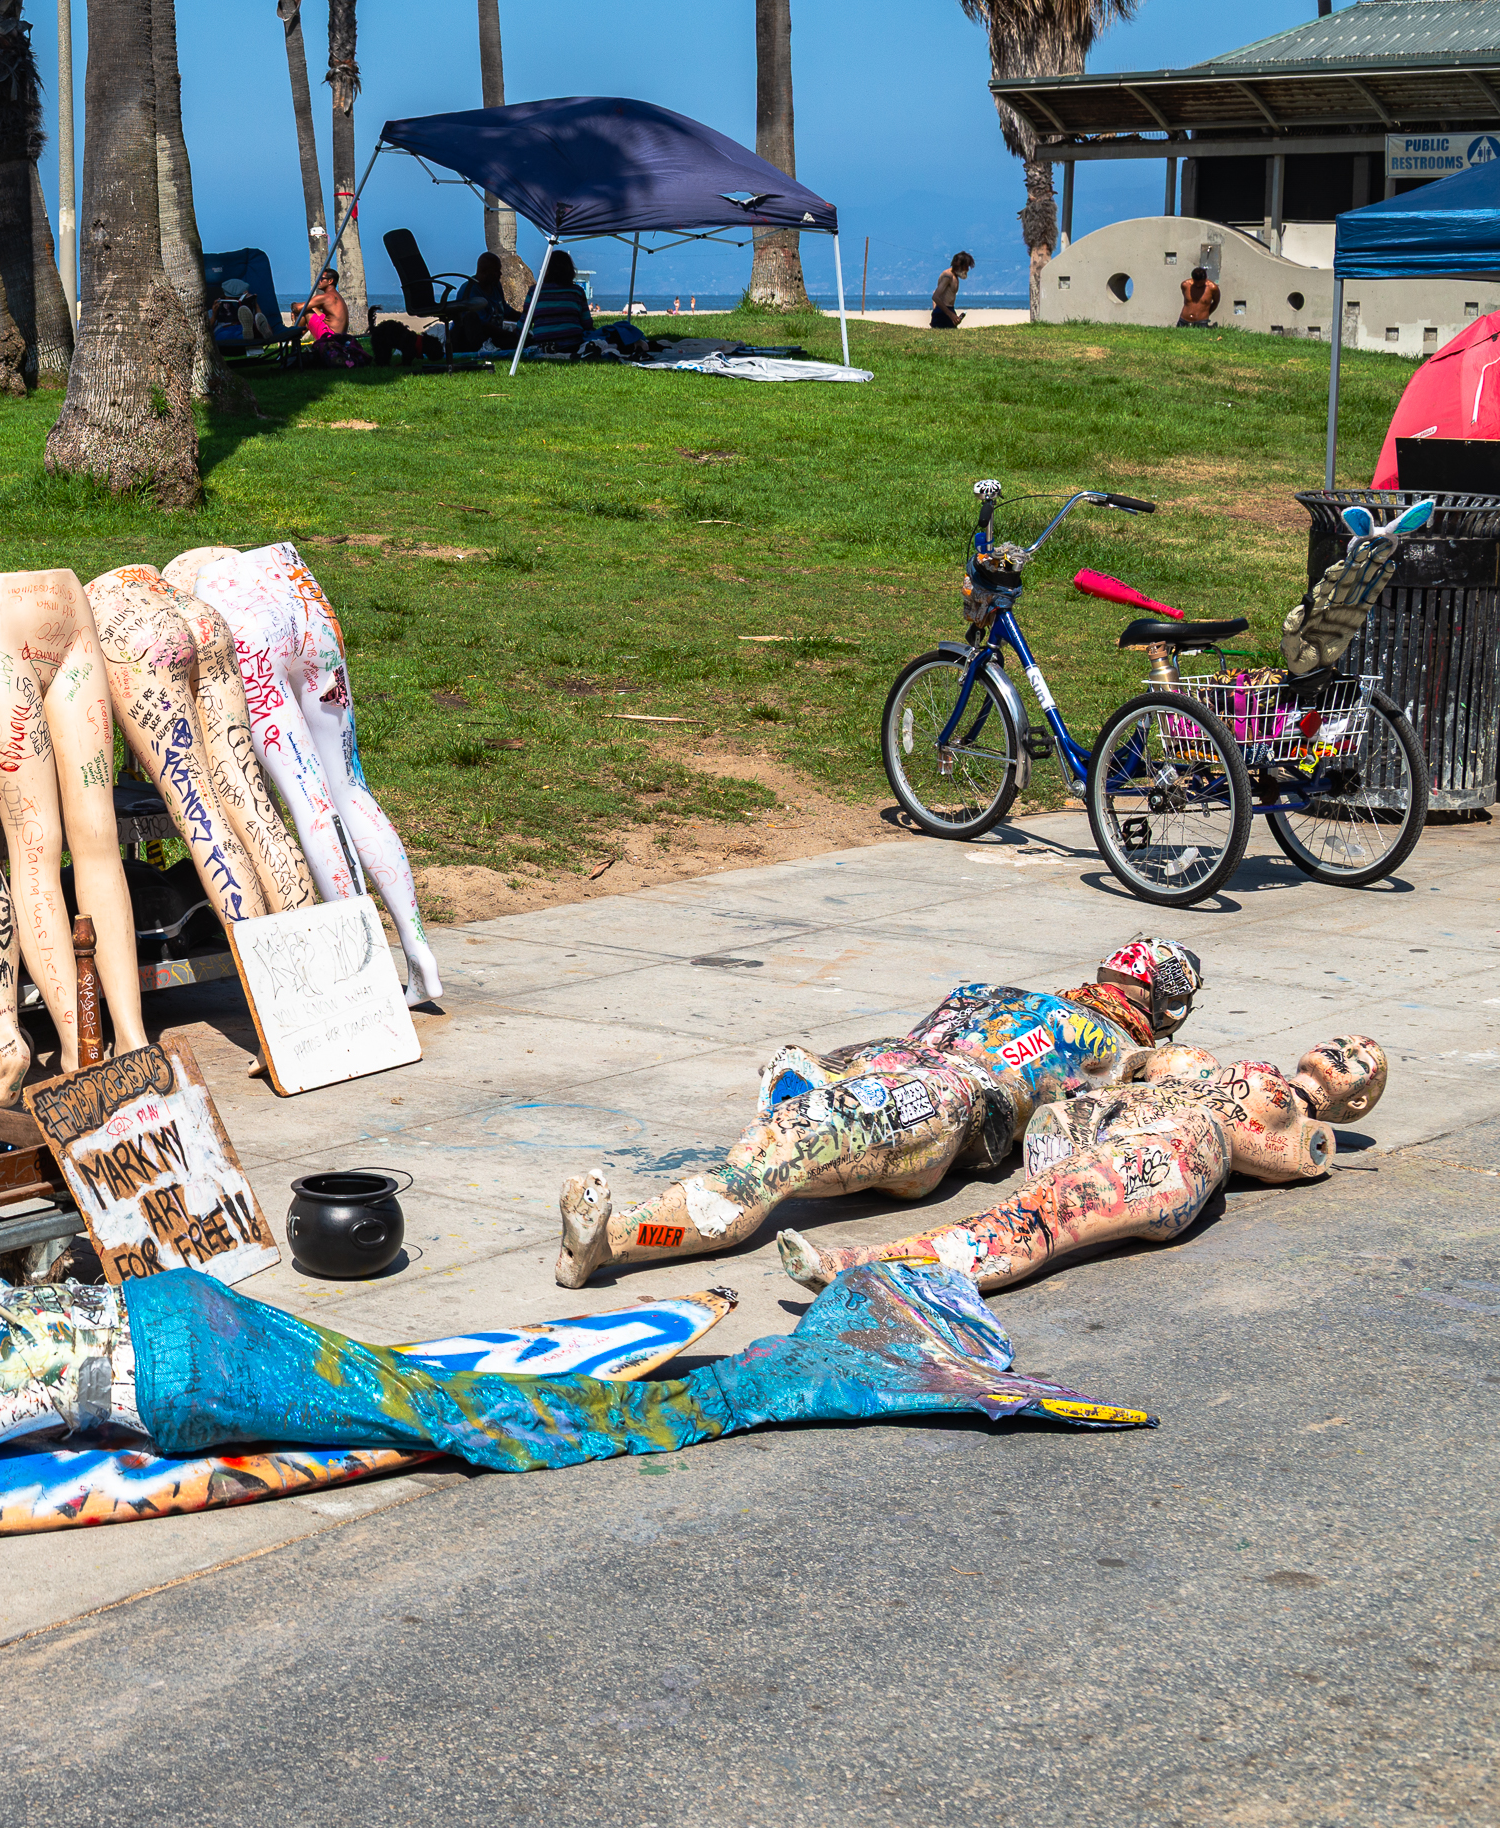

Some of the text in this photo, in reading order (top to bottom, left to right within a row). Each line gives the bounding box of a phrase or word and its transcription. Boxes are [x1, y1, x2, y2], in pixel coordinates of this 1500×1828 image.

[1391, 156, 1464, 170] RESTROOMS
[1405, 138, 1450, 152] PUBLIC
[78, 1133, 153, 1211] MARK
[150, 1119, 190, 1172] MY
[141, 1183, 191, 1237] ART
[114, 1234, 166, 1282] FOR
